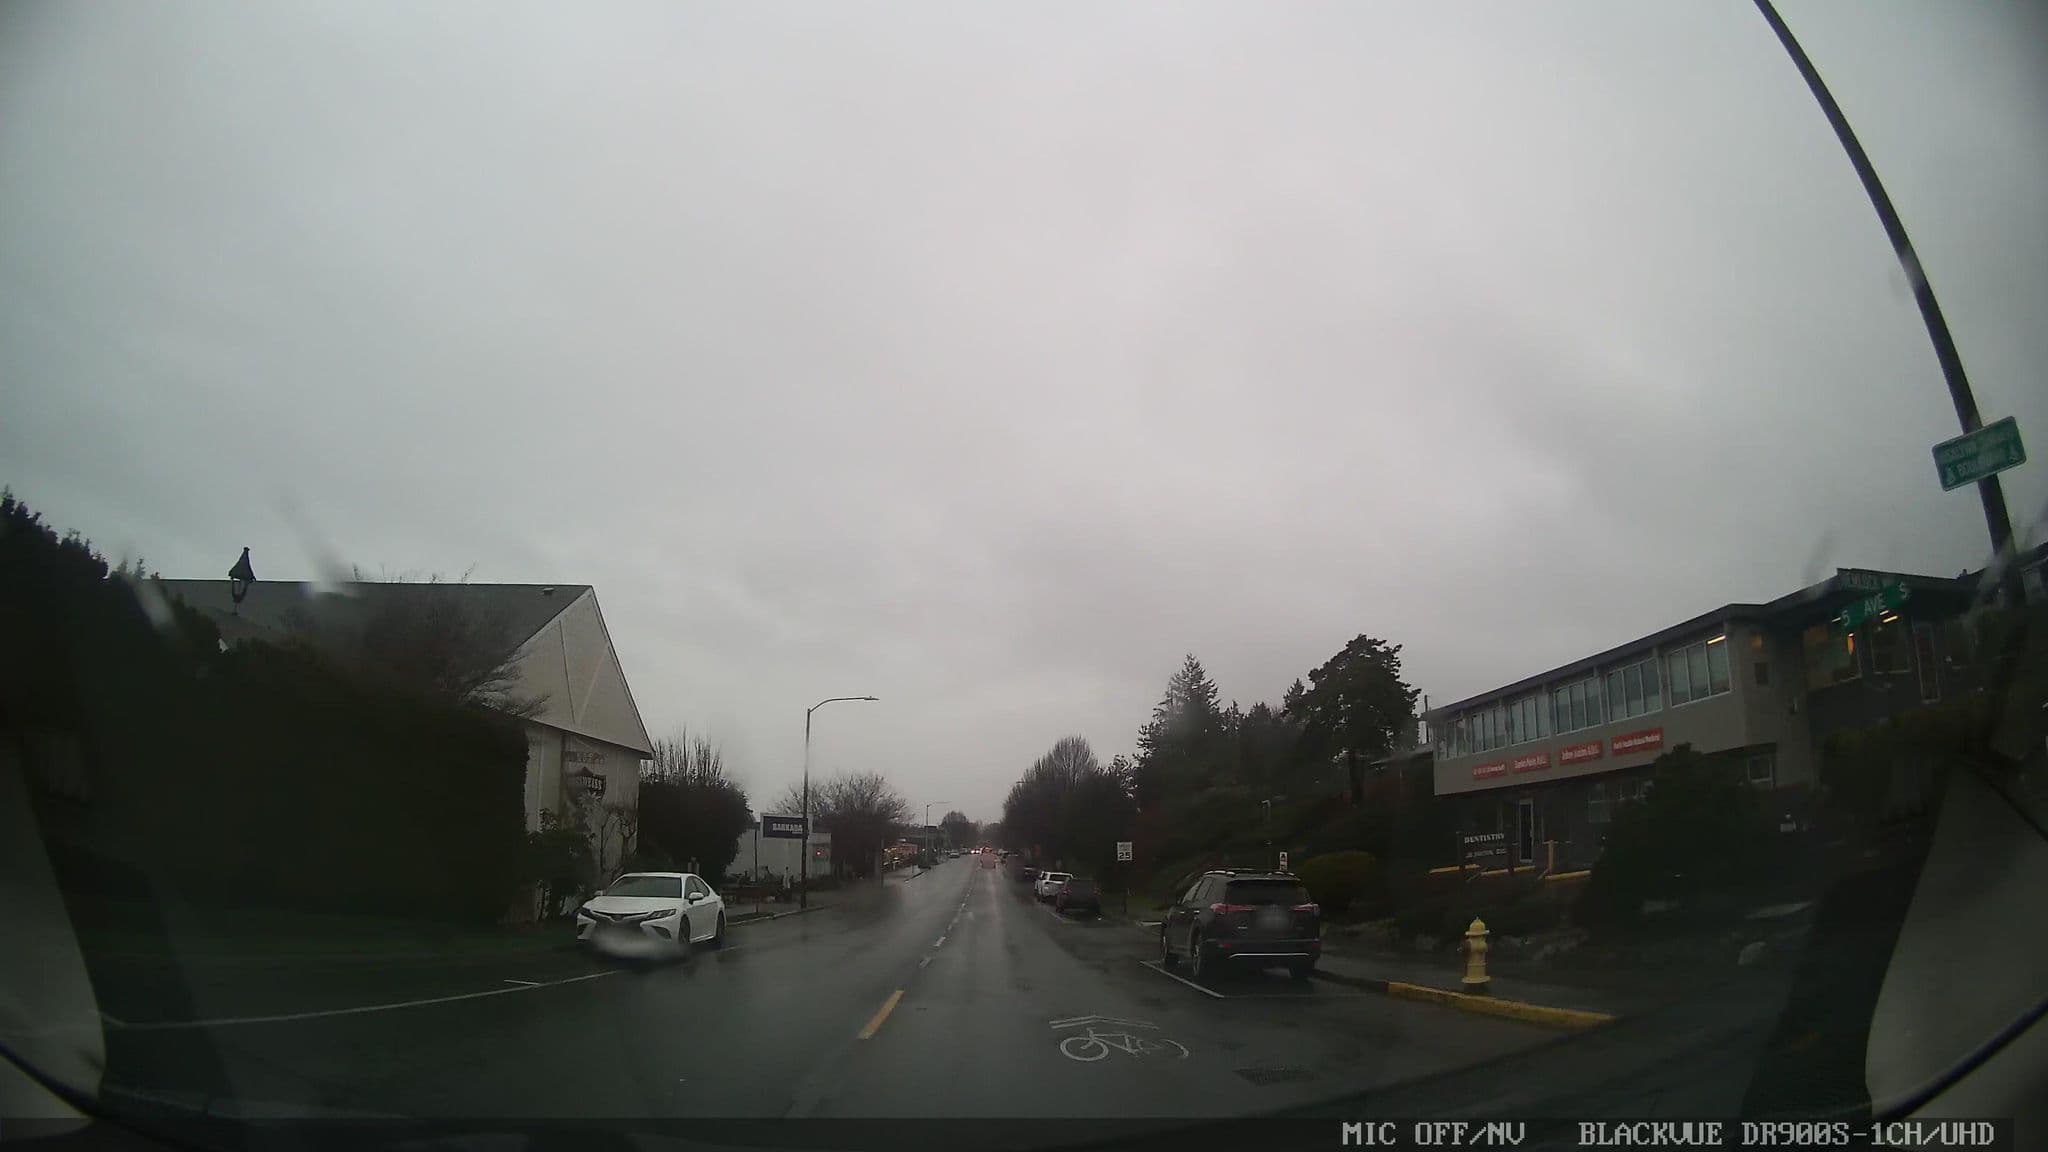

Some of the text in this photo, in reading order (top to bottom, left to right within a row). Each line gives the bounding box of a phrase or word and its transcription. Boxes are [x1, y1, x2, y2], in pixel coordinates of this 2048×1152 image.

[1864, 592, 1887, 616] AVE
[1898, 581, 1910, 600] S
[1464, 832, 1505, 844] DENTISTRY
[1119, 851, 1131, 859] 25
